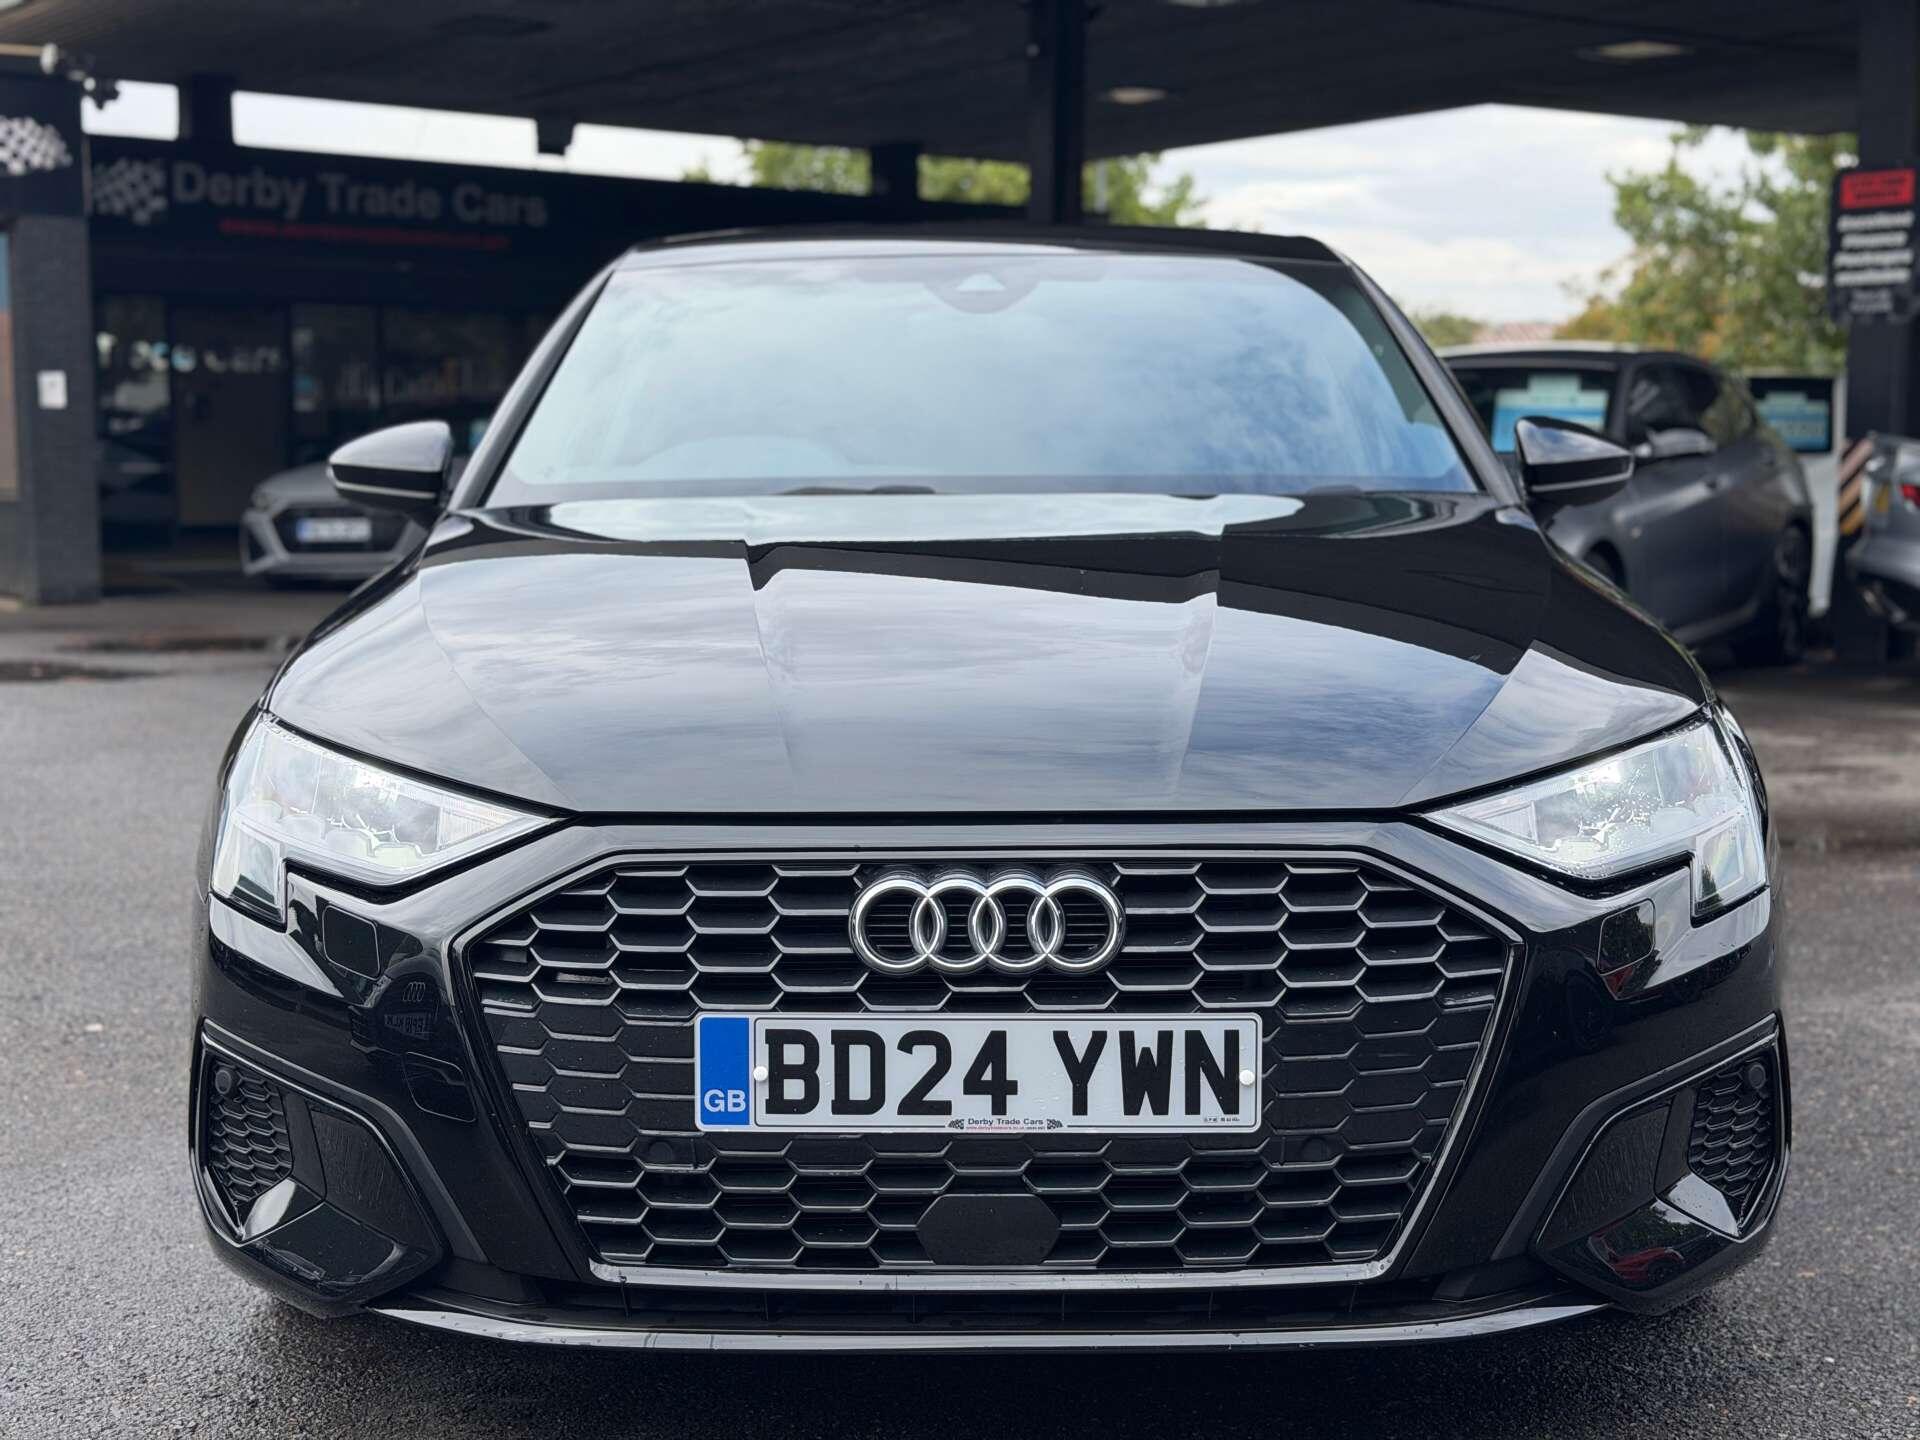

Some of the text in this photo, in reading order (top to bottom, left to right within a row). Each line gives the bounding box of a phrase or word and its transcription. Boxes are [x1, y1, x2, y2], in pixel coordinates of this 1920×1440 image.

[173, 162, 548, 227] Derby Trade Cars
[765, 1028, 1240, 1116] BD24 YWN
[704, 1089, 747, 1113] GB
[967, 1118, 1044, 1127] Derby Trade Cars
